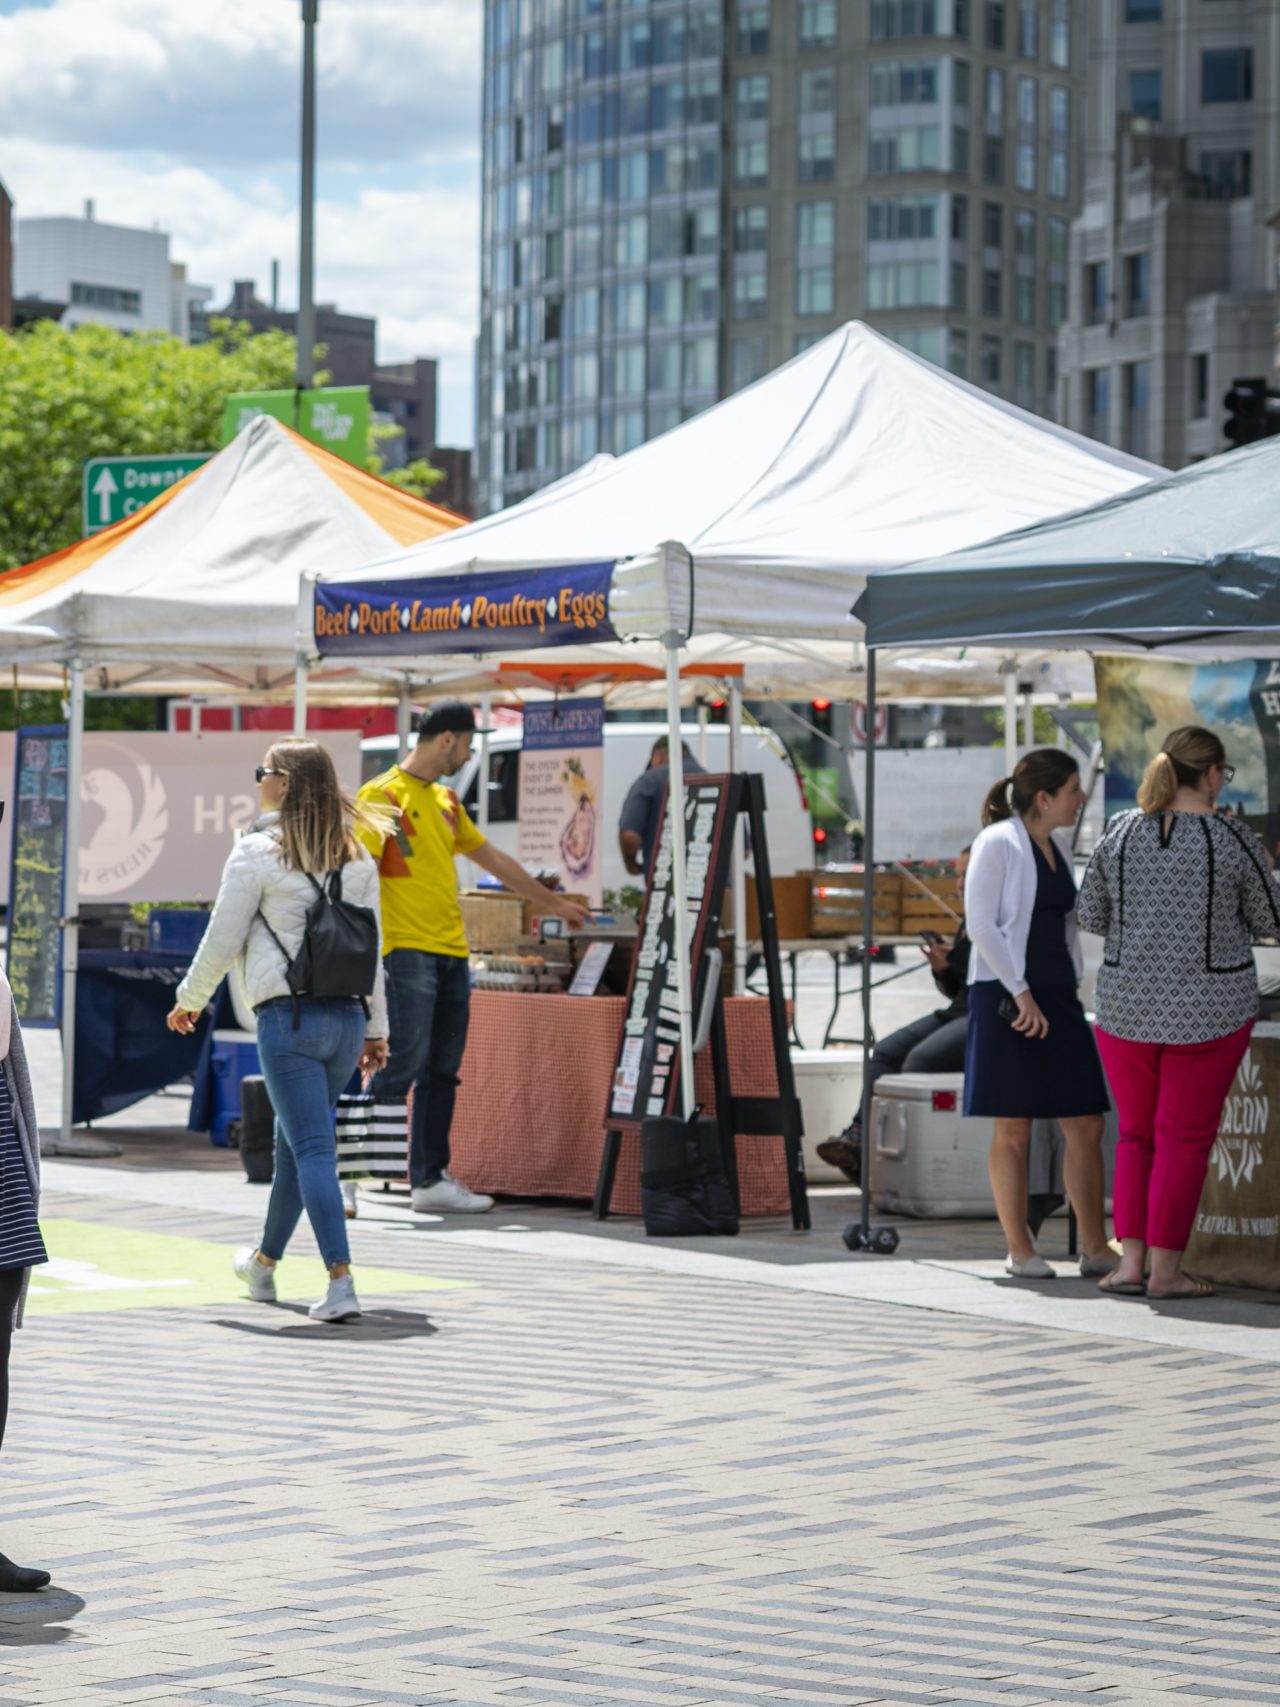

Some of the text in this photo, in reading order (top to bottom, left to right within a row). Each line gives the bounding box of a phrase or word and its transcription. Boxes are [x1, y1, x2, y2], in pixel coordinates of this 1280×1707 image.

[124, 467, 193, 489] Downt
[315, 588, 605, 636] Beef Pork Lamb Poultry Eggs
[1221, 1096, 1268, 1134] ACON
